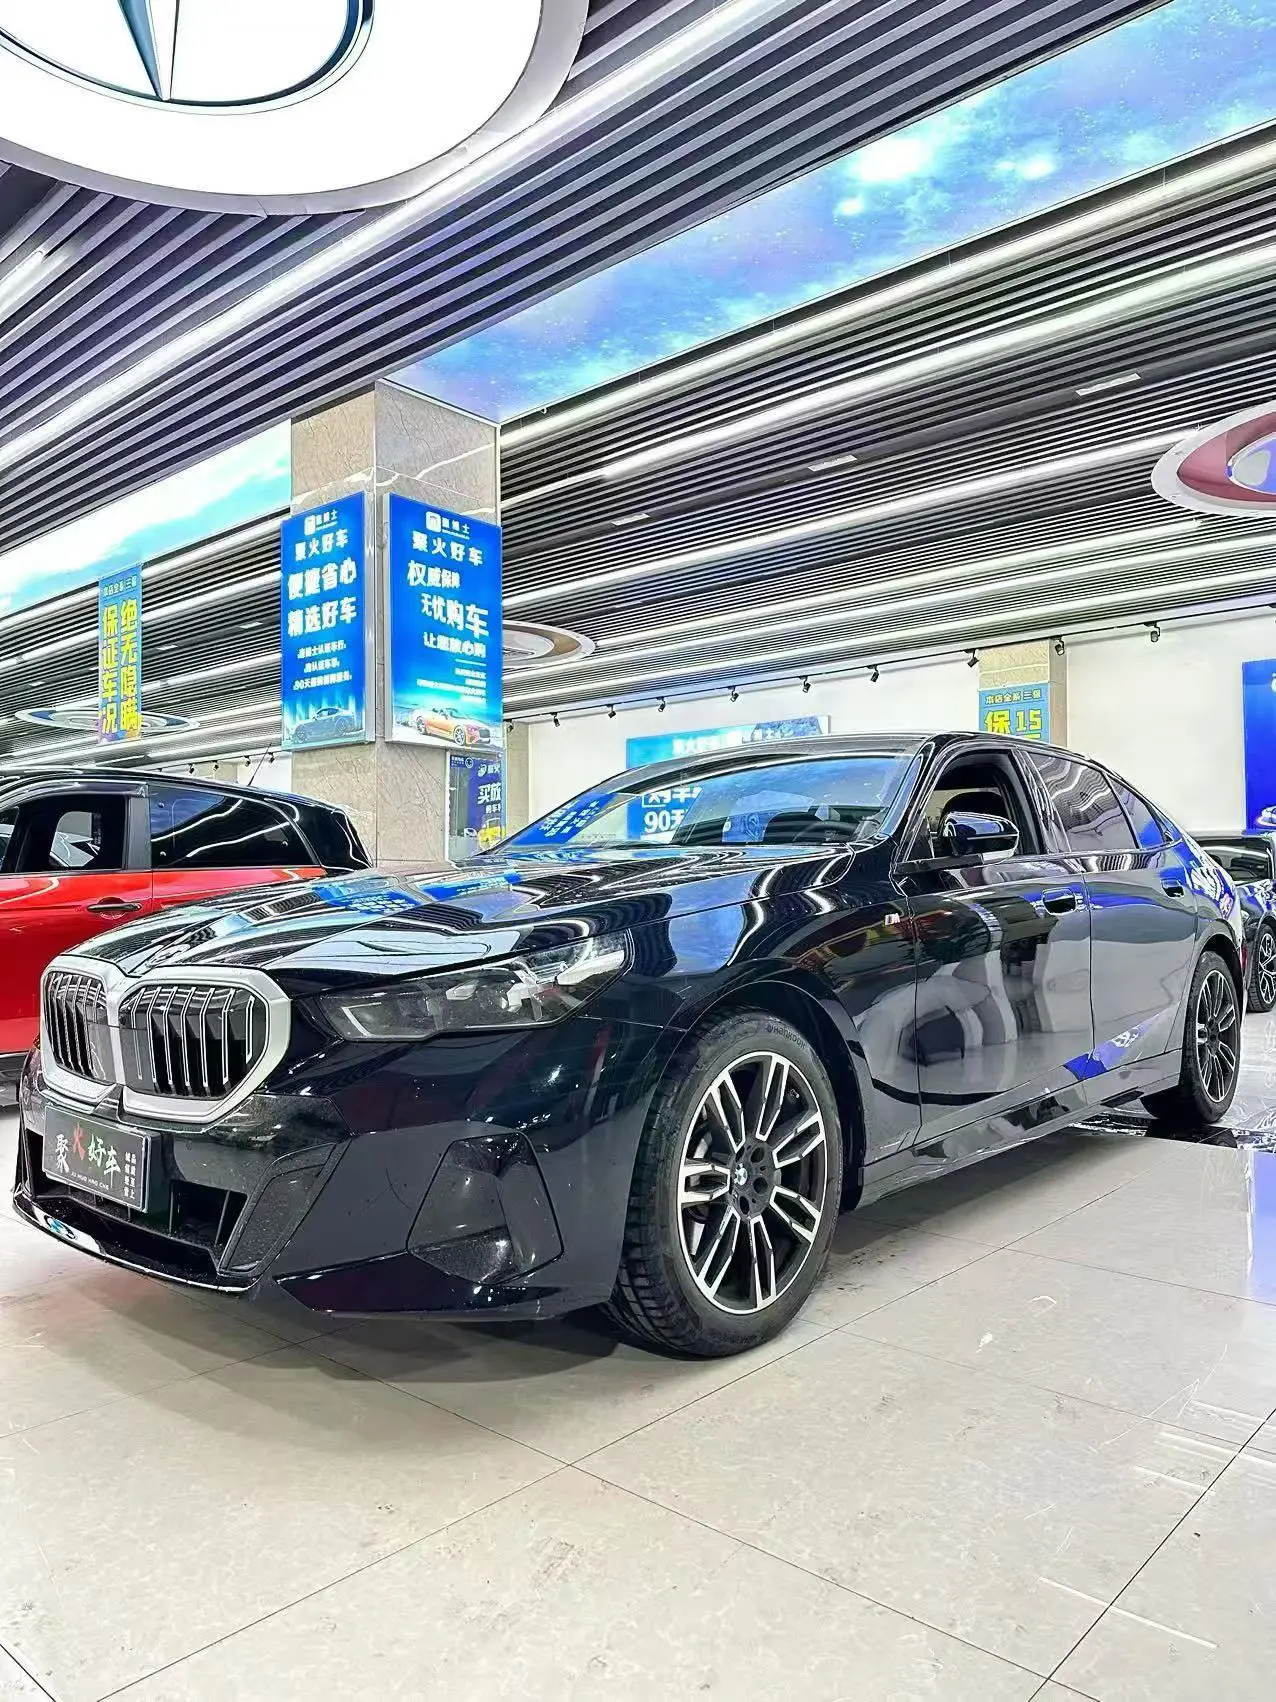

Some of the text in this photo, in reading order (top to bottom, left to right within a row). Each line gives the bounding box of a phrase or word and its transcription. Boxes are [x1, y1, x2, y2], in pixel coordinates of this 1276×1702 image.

[421, 593, 489, 639] 无忧购车
[101, 604, 119, 735] 保证车况
[119, 599, 138, 731] 绝无隐瞒
[984, 709, 1011, 735] 保
[1016, 709, 1042, 732] 15
[55, 1122, 121, 1188] 聚火好车
